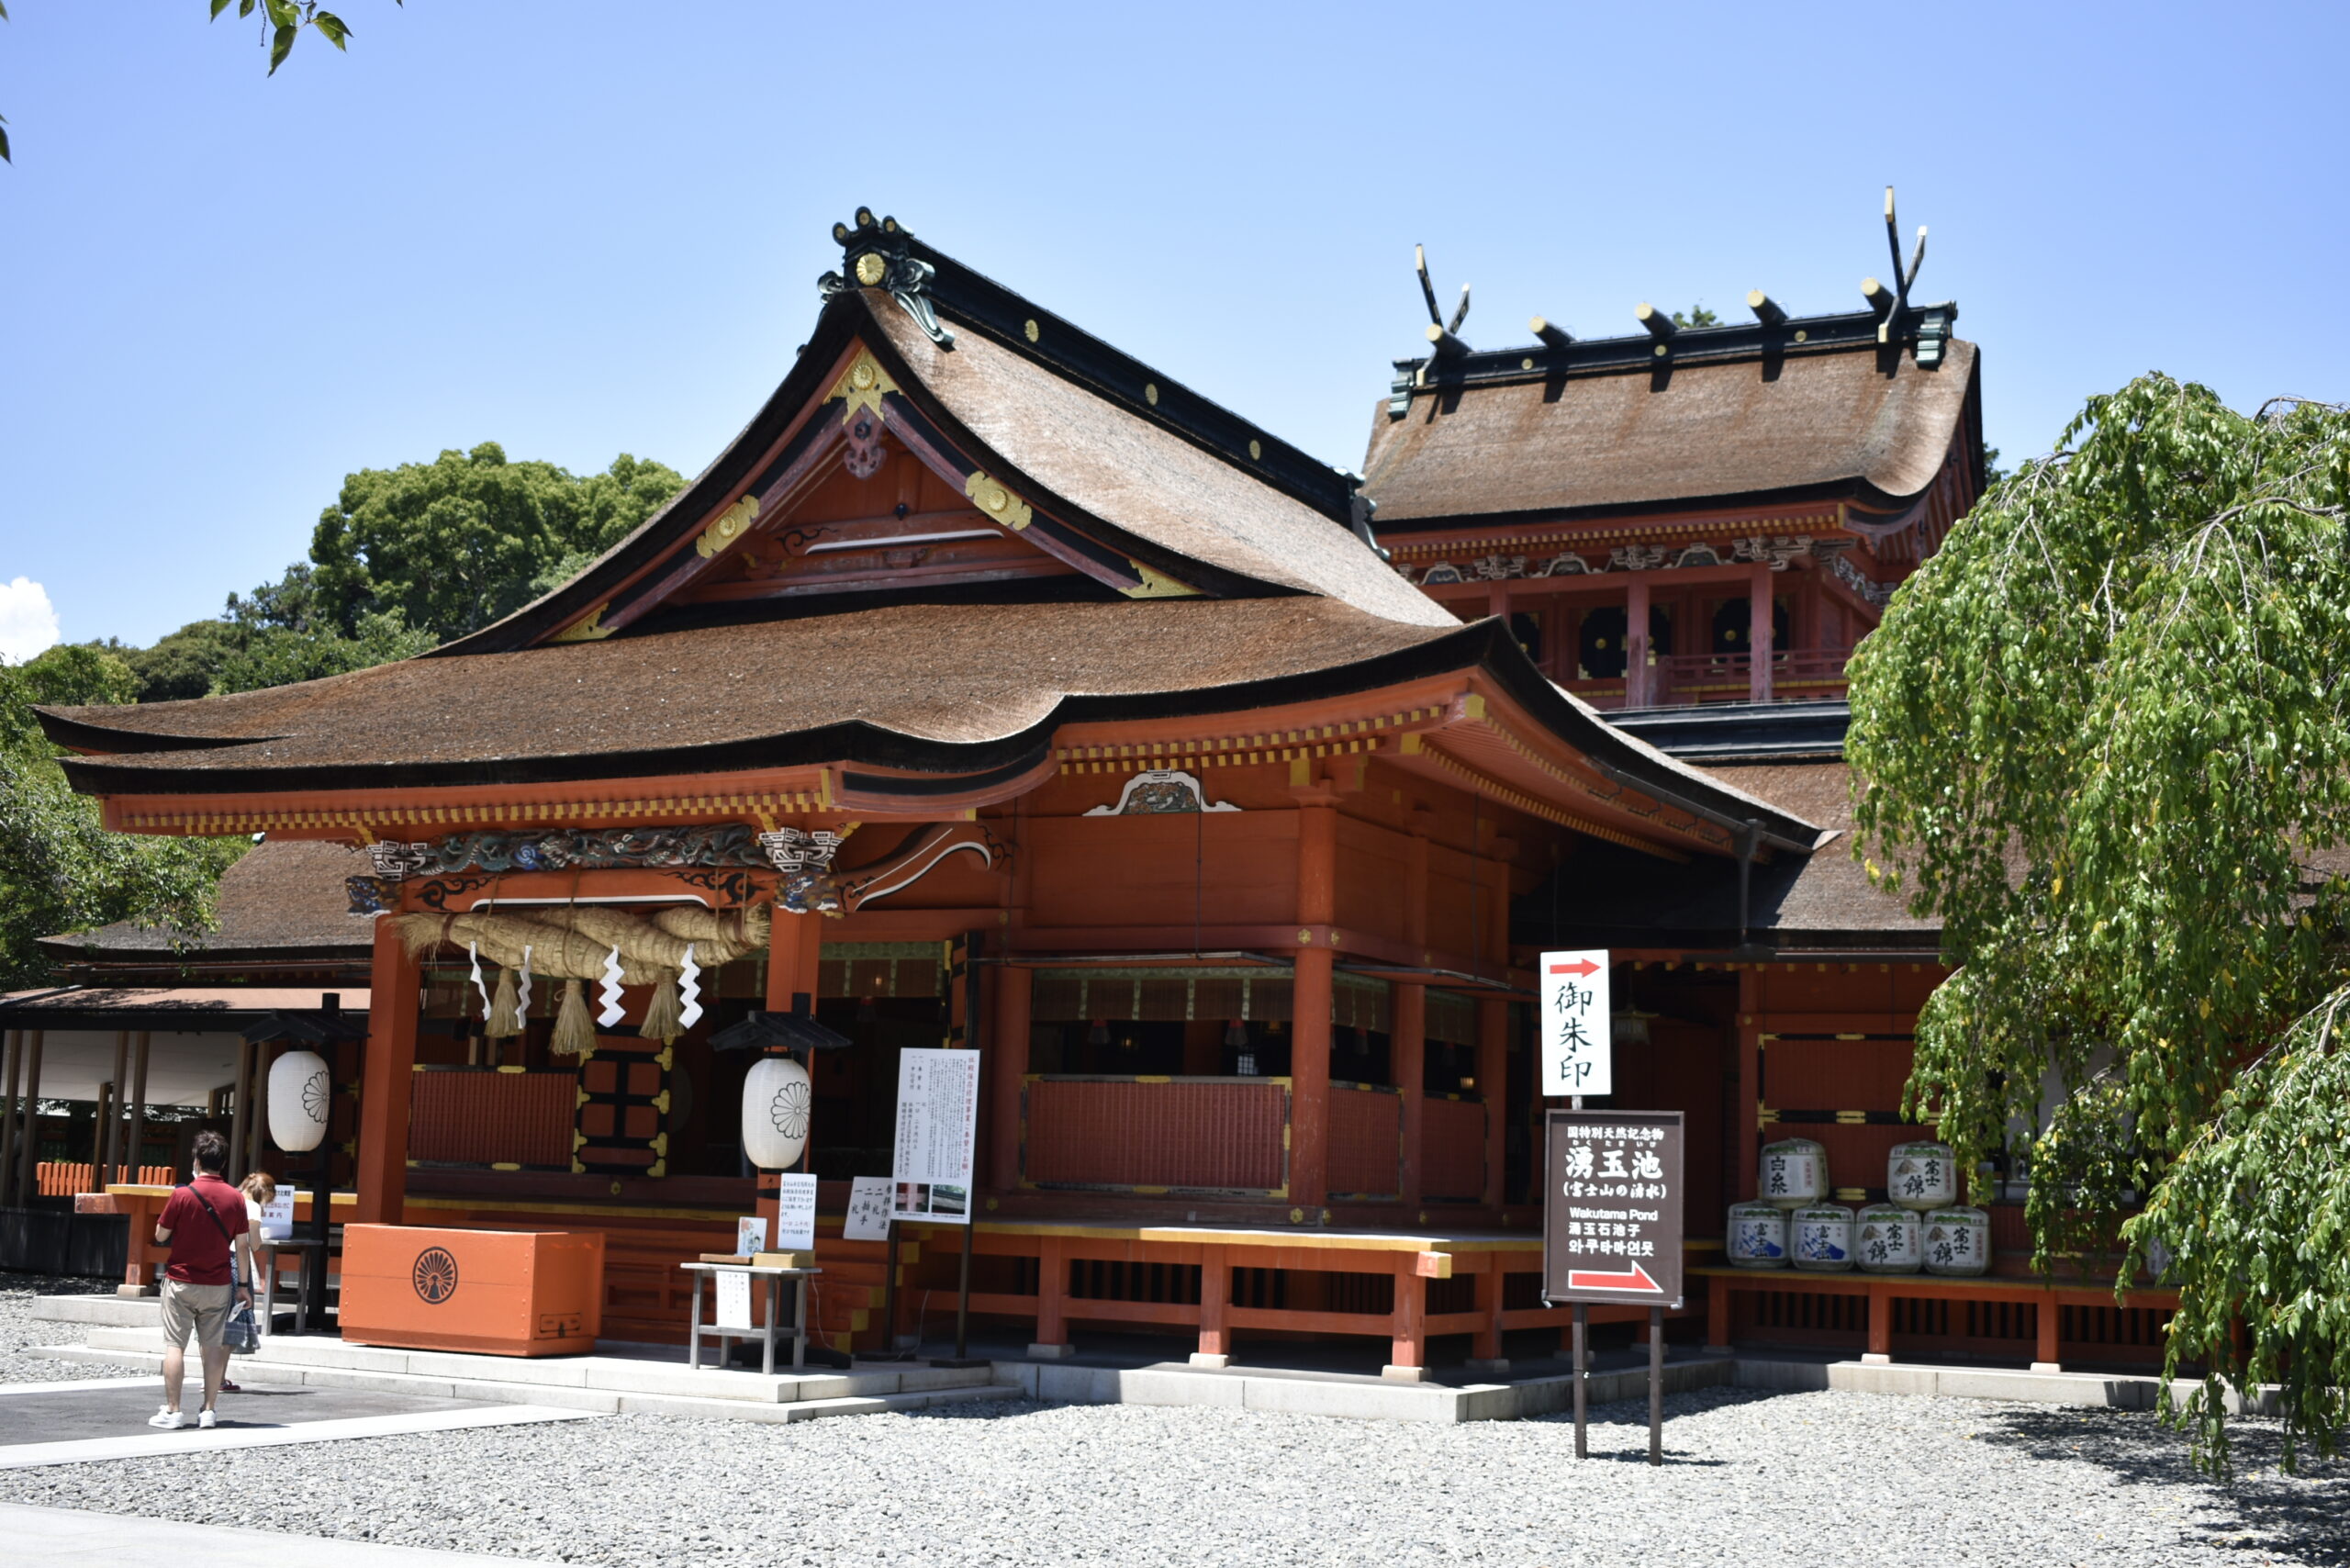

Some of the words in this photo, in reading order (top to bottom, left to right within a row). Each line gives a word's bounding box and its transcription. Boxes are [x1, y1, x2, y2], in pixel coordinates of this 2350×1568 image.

[1554, 981, 1594, 1088] 御朱印
[1567, 1126, 1664, 1141] 国特別天然記念物
[1565, 1146, 1663, 1180] 湧玉池
[852, 1189, 863, 1215] 一礼
[859, 1187, 873, 1226] 二拍手
[872, 1188, 883, 1215] 二礼
[1569, 1206, 1628, 1220] Wakutama
[1629, 1209, 1659, 1222] Pond
[1568, 1238, 1655, 1258] 와쿠타마연못
